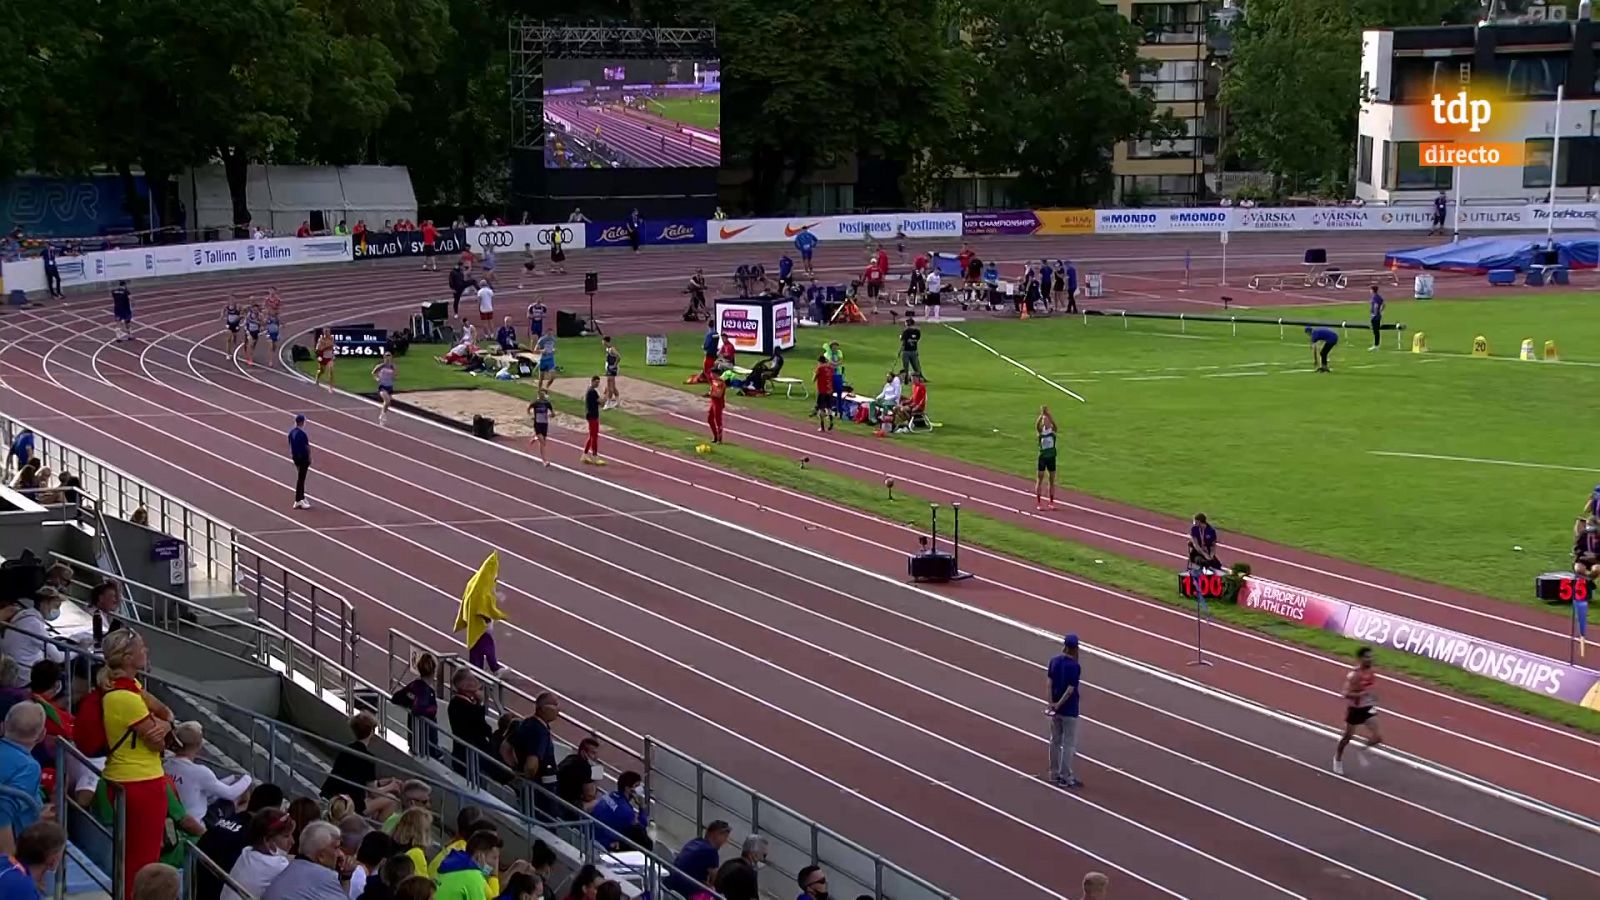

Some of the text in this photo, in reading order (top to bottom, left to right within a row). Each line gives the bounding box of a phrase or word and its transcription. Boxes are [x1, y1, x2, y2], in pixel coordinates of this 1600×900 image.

[1111, 214, 1157, 223] MONDO
[1179, 212, 1226, 222] MONDO
[1470, 212, 1521, 222] UTILITAS
[903, 219, 957, 231] Postimees
[656, 224, 695, 240] Kalev
[258, 246, 291, 259] Tallinn
[411, 239, 454, 253] SYLAB
[204, 250, 237, 263] Tallinn
[1474, 341, 1486, 352] 20
[1263, 586, 1308, 609] EUROPEAN
[1260, 599, 1305, 620] ATHLETICS
[1353, 614, 1565, 695] U23 CHAMPIONSHIPS
